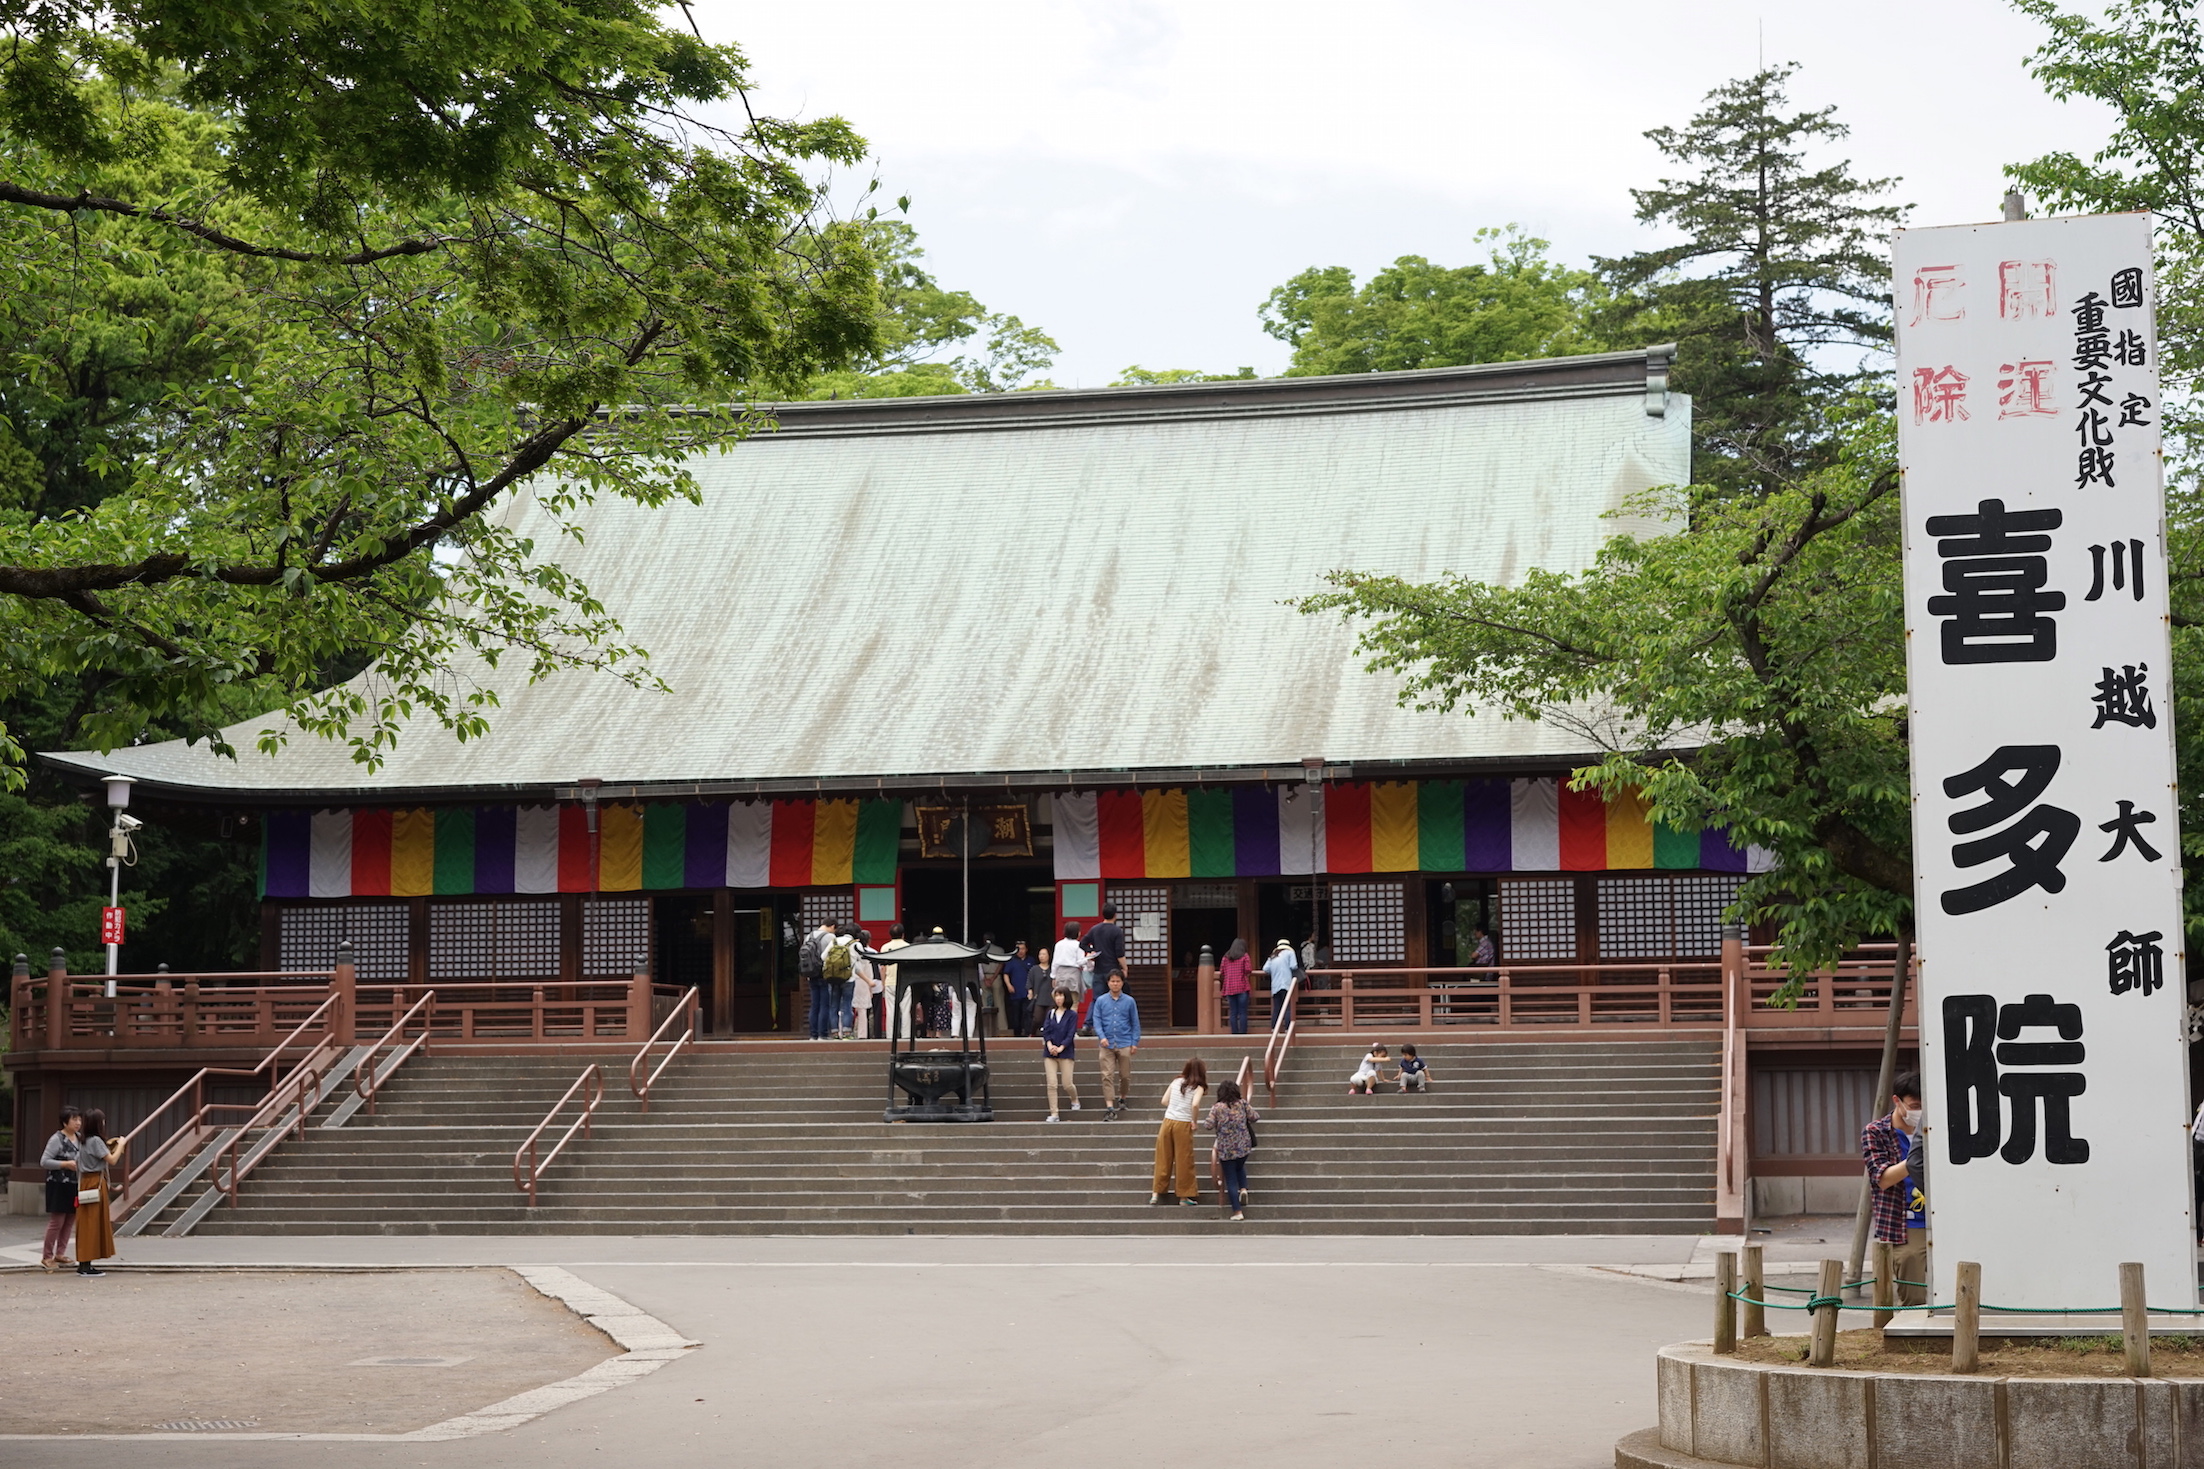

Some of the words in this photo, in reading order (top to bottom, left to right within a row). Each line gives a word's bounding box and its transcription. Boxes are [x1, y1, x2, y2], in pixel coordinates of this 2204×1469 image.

[1909, 263, 1971, 427] 厄除
[2111, 267, 2152, 428] 國指定
[1925, 498, 2090, 1166] 喜多院
[2084, 538, 2164, 997] 川越大師
